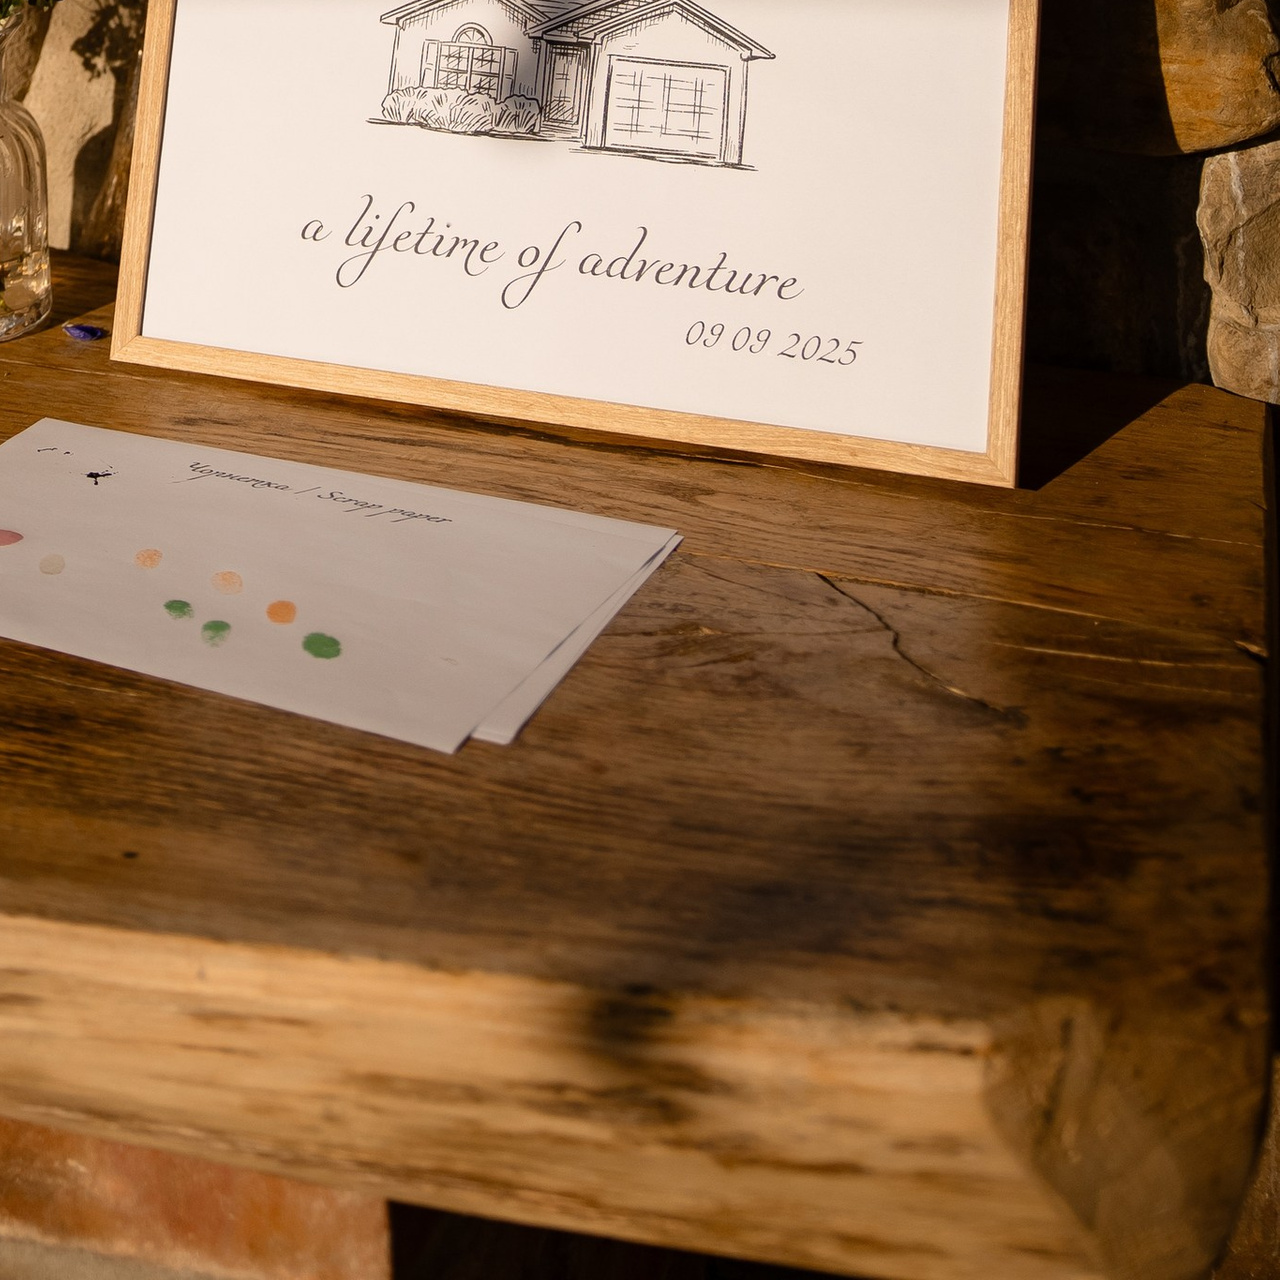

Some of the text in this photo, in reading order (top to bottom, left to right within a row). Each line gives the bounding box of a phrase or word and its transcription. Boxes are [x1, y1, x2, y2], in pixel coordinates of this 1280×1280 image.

[301, 194, 805, 309] a lifetime of adventure
[685, 320, 864, 366] 09 09 2025
[317, 491, 383, 513] Scrap
[365, 507, 452, 523] paper
